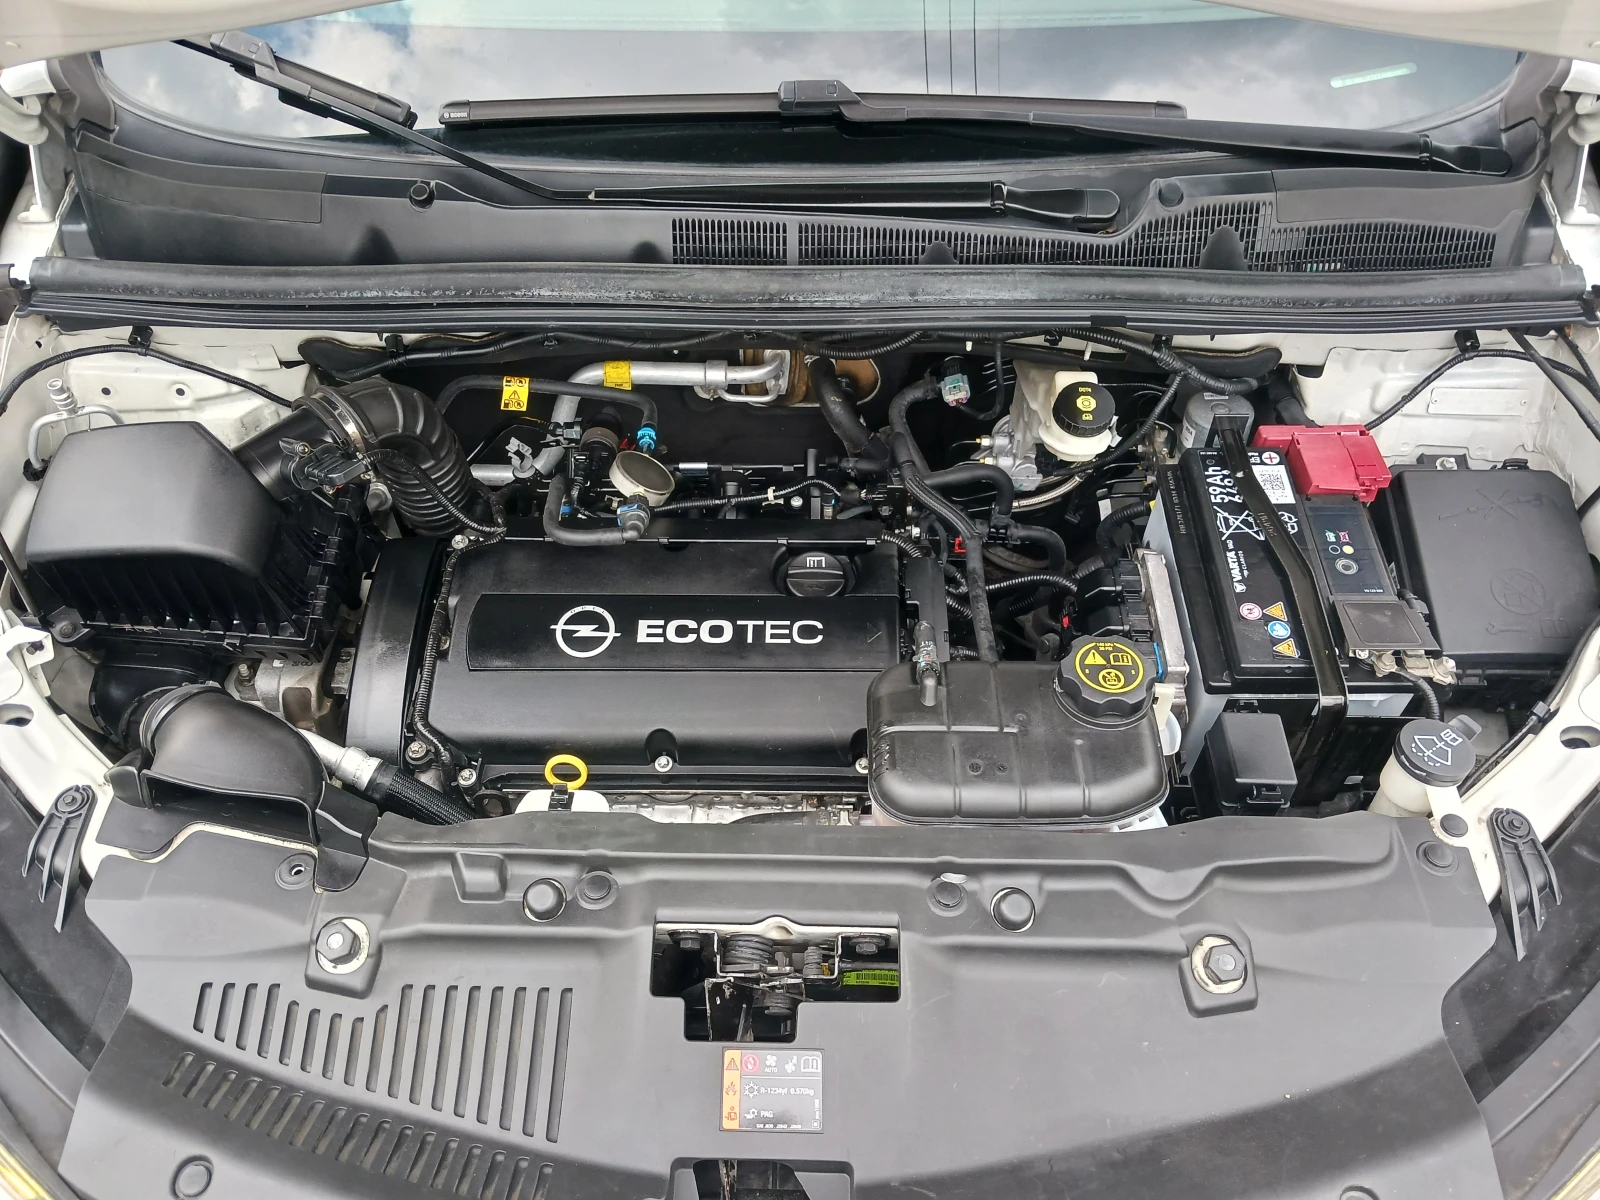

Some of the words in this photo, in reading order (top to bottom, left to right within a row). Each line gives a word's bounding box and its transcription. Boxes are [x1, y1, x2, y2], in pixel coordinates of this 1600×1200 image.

[1205, 466, 1228, 503] 59Ah
[1226, 551, 1242, 582] VARTA
[636, 619, 824, 645] ECOTEC
